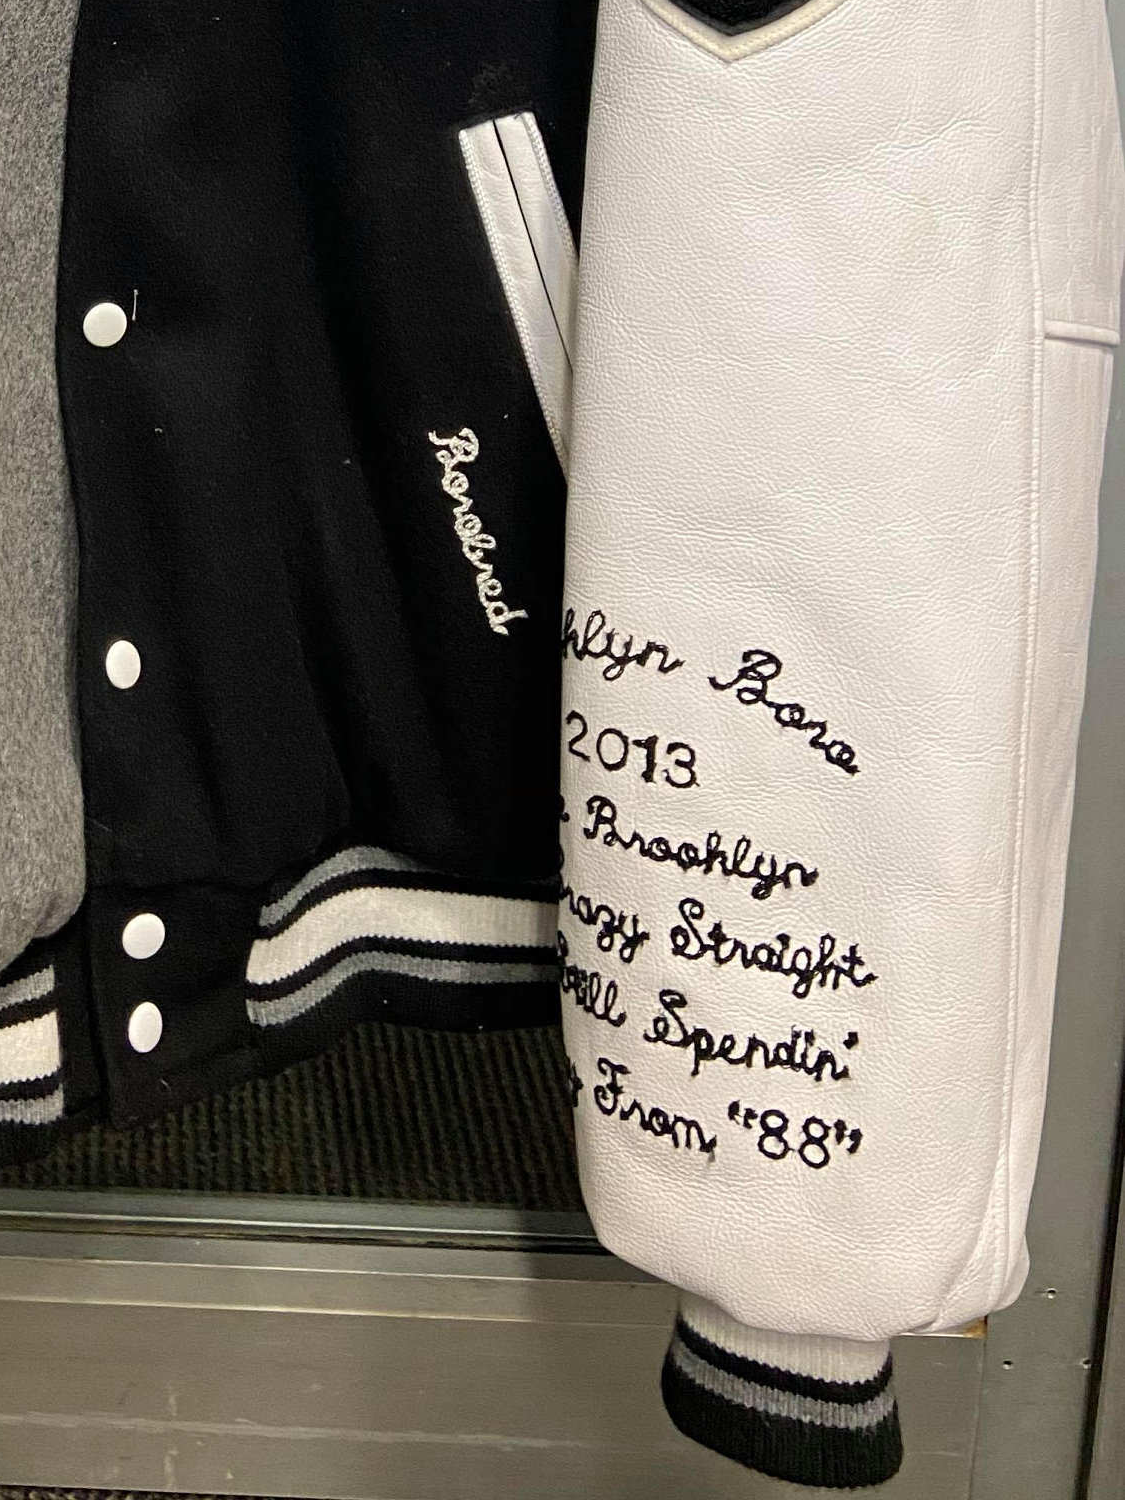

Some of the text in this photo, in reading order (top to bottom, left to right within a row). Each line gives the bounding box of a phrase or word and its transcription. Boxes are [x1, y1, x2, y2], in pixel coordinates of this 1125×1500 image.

[565, 710, 700, 788] 2013
[582, 795, 820, 899] Brooklyn
[670, 897, 879, 999] Straight
[593, 1057, 717, 1154] From
